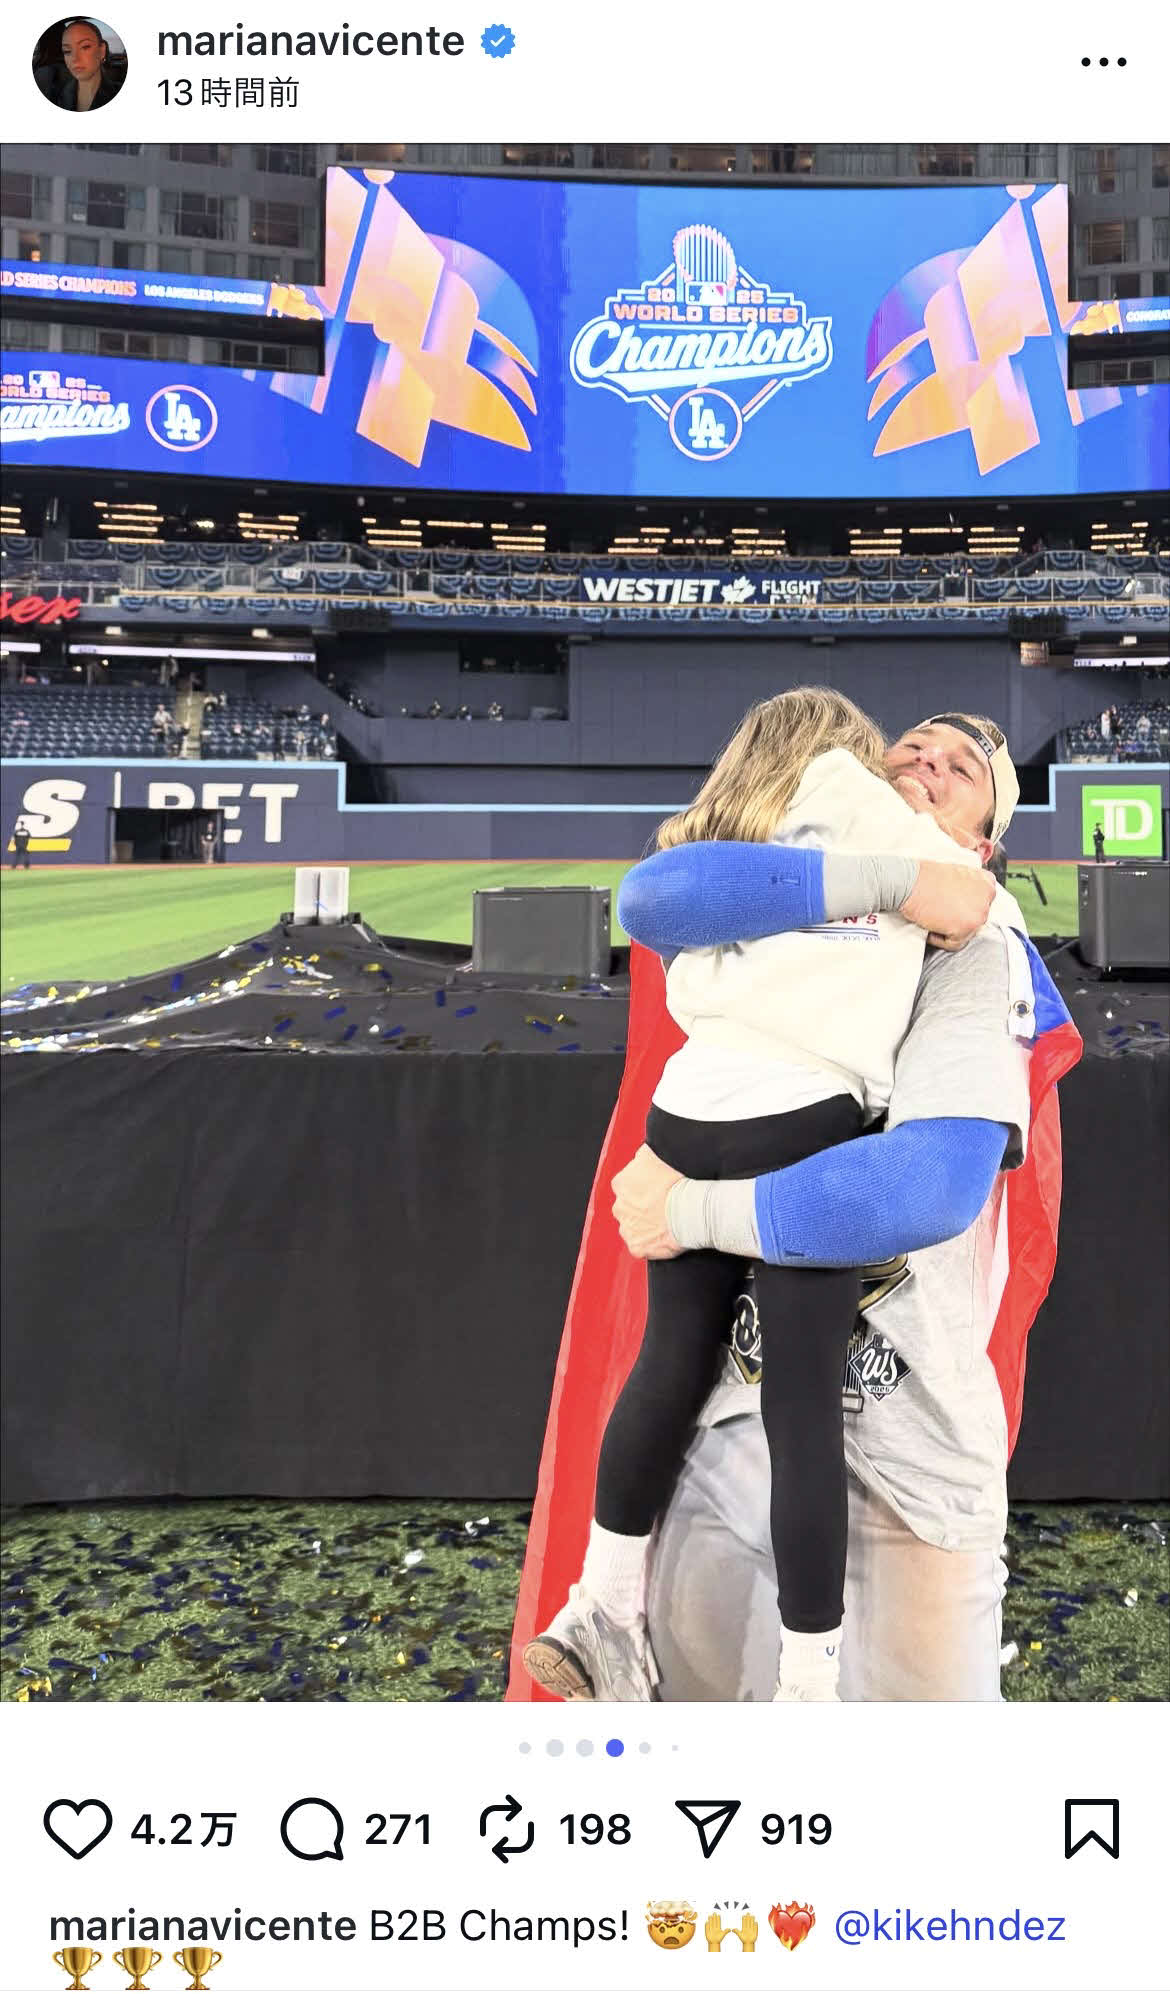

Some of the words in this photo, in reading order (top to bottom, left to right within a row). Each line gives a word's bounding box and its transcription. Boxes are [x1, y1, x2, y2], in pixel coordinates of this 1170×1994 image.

[613, 303, 702, 322] WORLD
[709, 306, 799, 324] SERIES
[648, 288, 675, 302] 20
[575, 320, 828, 388] Champions
[164, 391, 201, 442] LA
[688, 397, 726, 449] LA
[583, 578, 721, 607] WESTJET
[761, 579, 822, 595] FLIGHT
[1090, 799, 1153, 841] TD
[861, 1348, 898, 1386] WS
